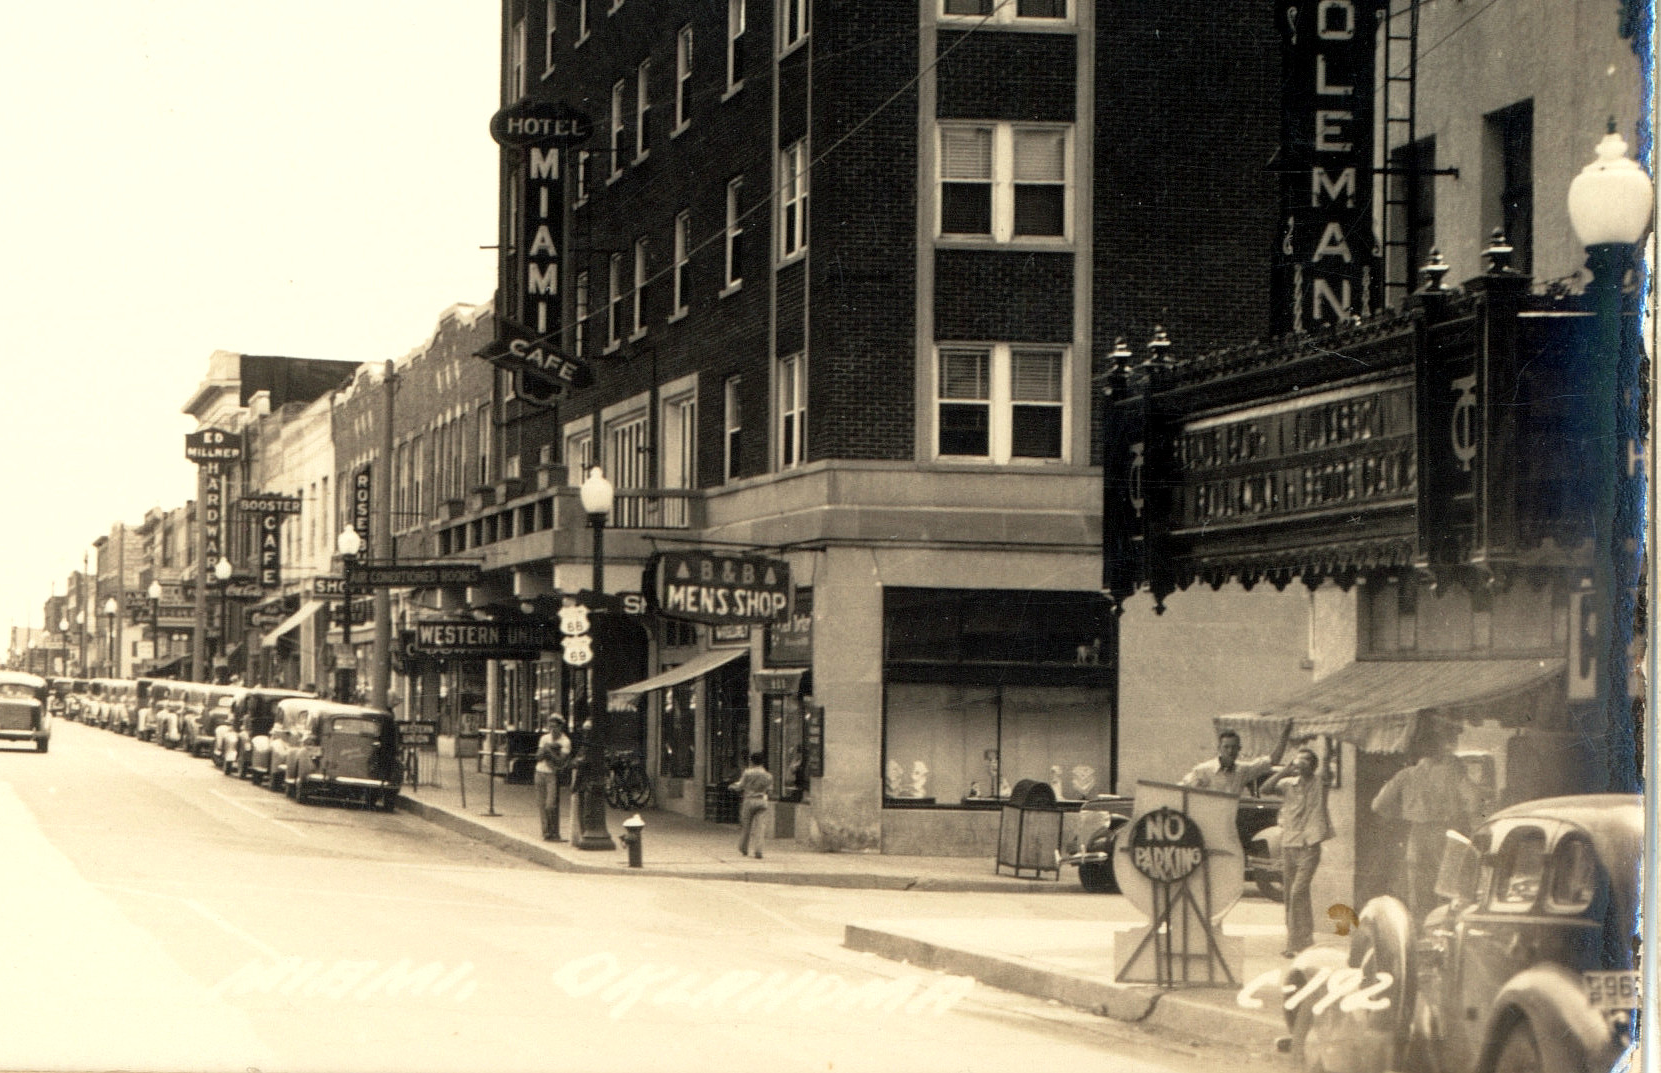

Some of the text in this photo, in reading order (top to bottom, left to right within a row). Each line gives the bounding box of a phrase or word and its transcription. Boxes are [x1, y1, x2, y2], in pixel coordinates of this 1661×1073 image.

[506, 117, 586, 137] HOTEL
[527, 147, 559, 334] MIAMI
[509, 338, 578, 382] CAFE
[203, 431, 225, 444] ED
[240, 499, 301, 512] BOOSTER
[206, 462, 219, 585] HARDWARE
[263, 516, 276, 584] CAFE
[700, 559, 755, 585] B & B
[668, 583, 787, 619] MENS SHOP
[419, 625, 499, 645] WESTERN
[1146, 813, 1185, 842] NO
[1134, 846, 1203, 881] PARKING
